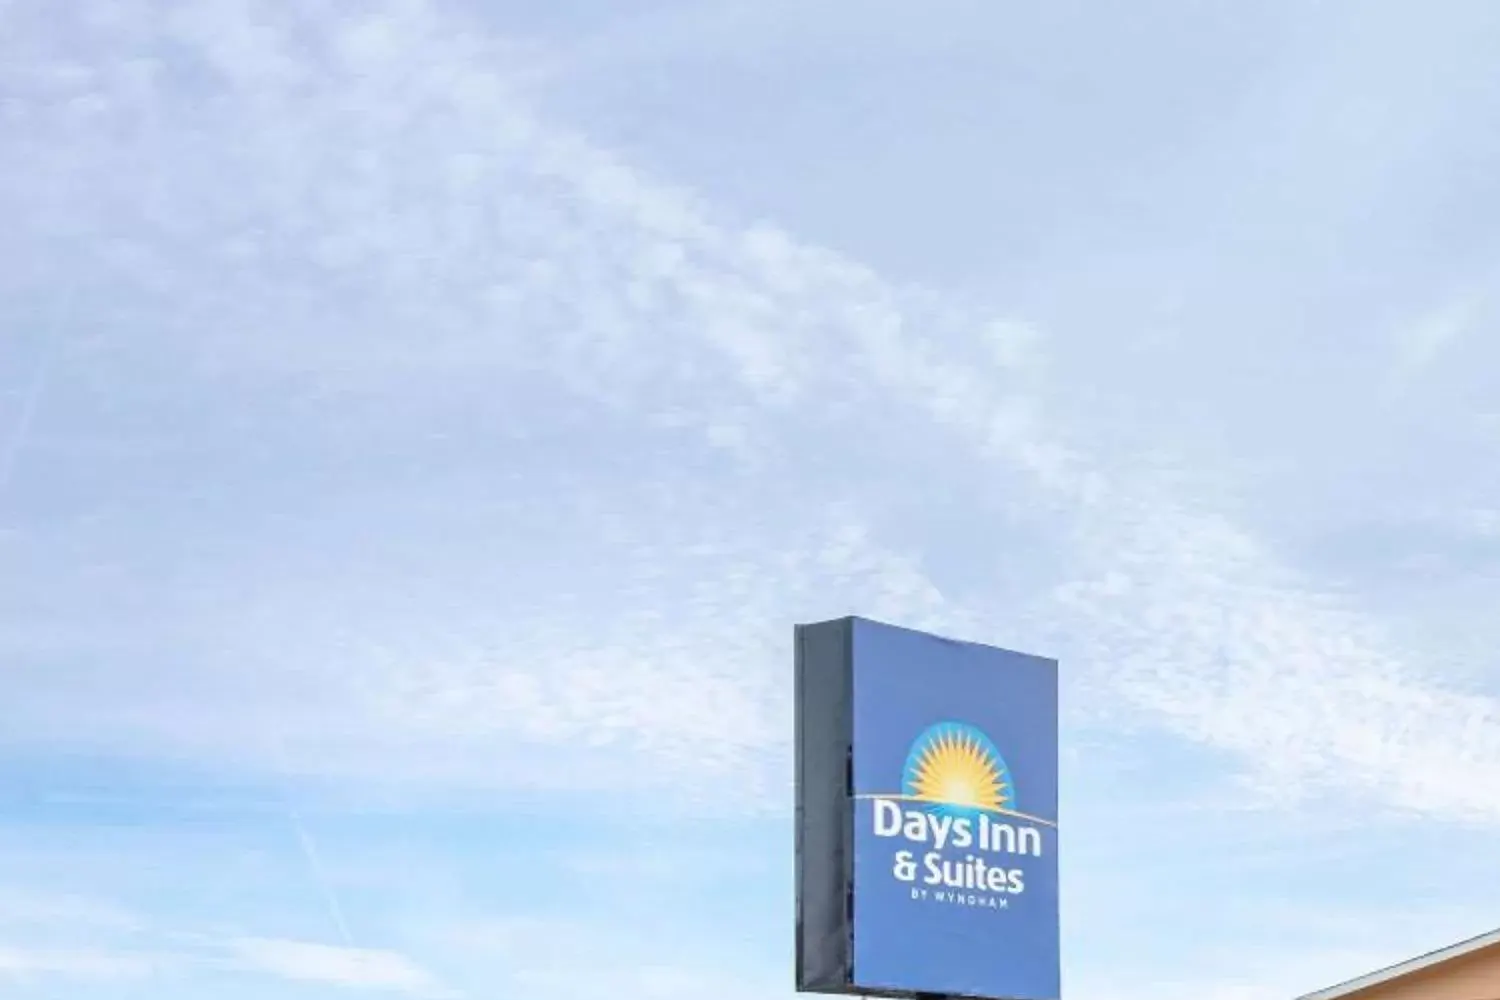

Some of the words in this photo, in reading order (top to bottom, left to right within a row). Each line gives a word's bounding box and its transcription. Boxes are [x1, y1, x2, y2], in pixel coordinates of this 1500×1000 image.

[874, 799, 972, 849] Days
[979, 815, 1041, 857] Inn
[893, 851, 918, 881] &
[924, 853, 1024, 894] Suites
[911, 888, 927, 900] BY
[935, 891, 1008, 909] WYNDHAM
